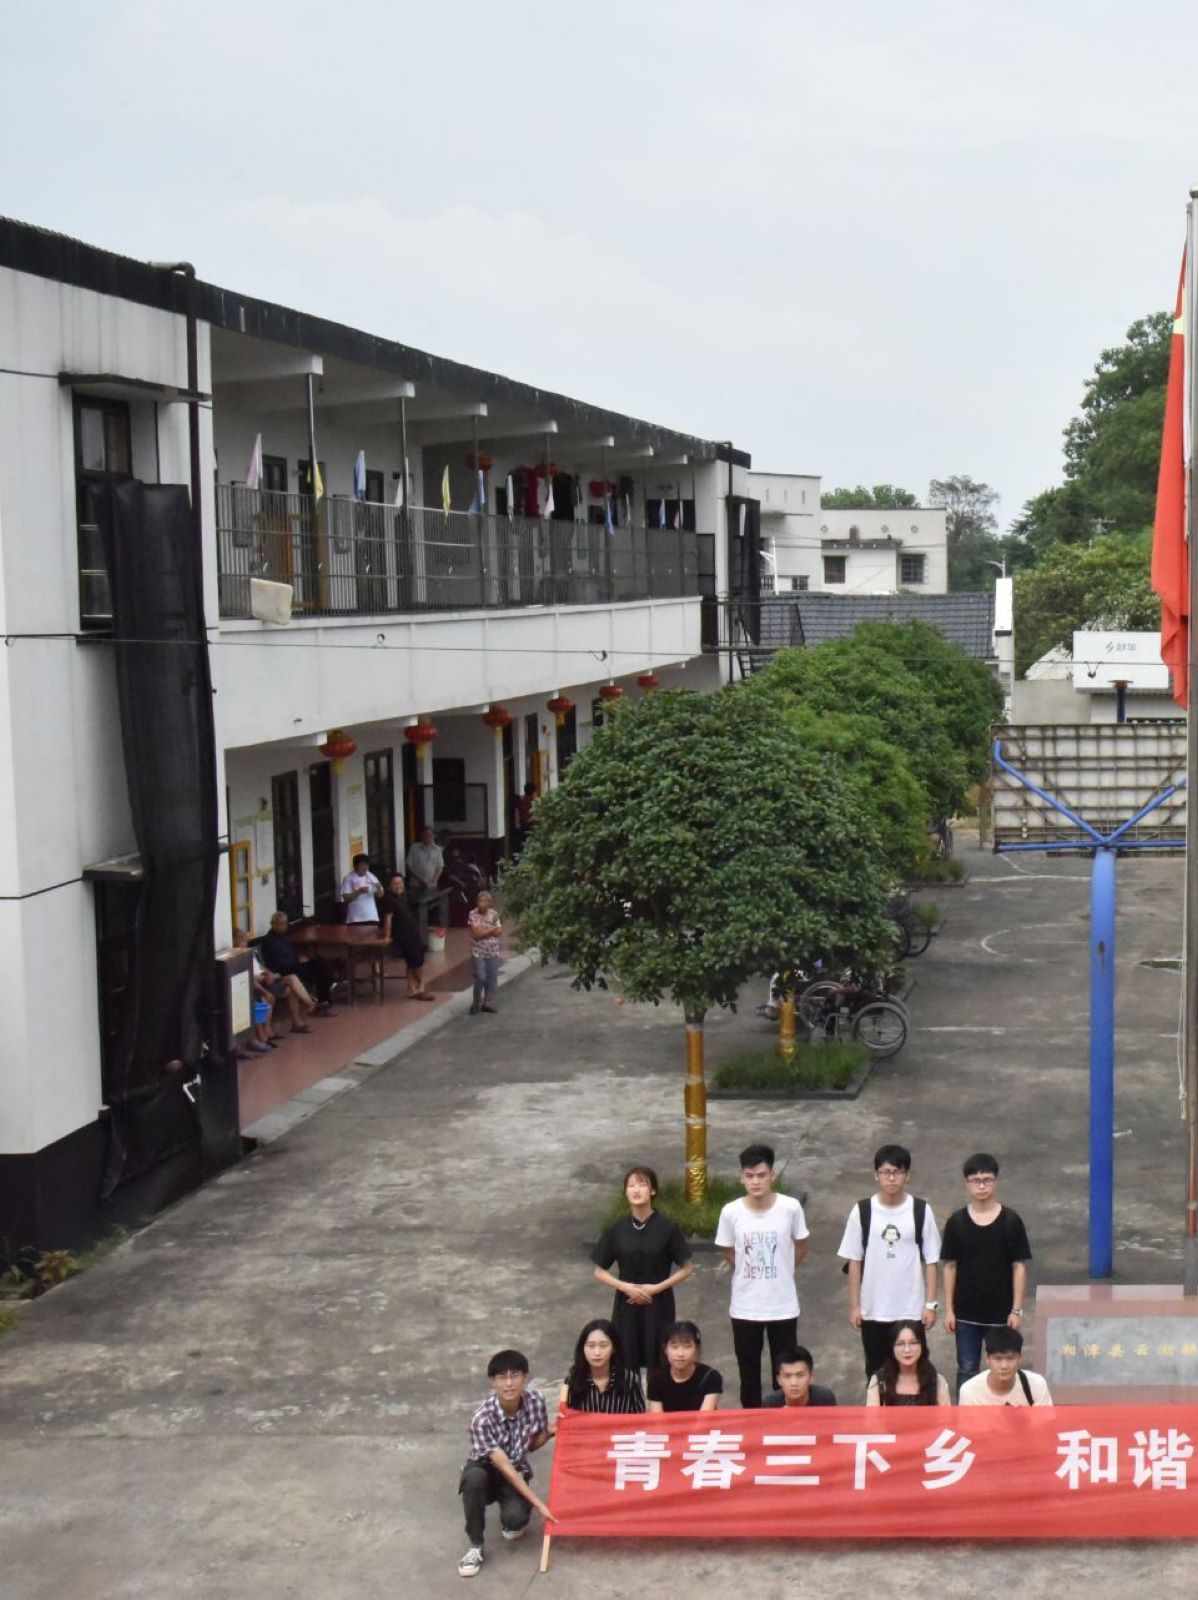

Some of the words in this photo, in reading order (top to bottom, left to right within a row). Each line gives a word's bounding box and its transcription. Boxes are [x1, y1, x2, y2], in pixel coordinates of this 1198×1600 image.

[743, 1231, 778, 1244] NEVER
[744, 1245, 777, 1266] SAY
[743, 1266, 777, 1279] NEVER
[606, 1429, 976, 1490] 青春三下乡
